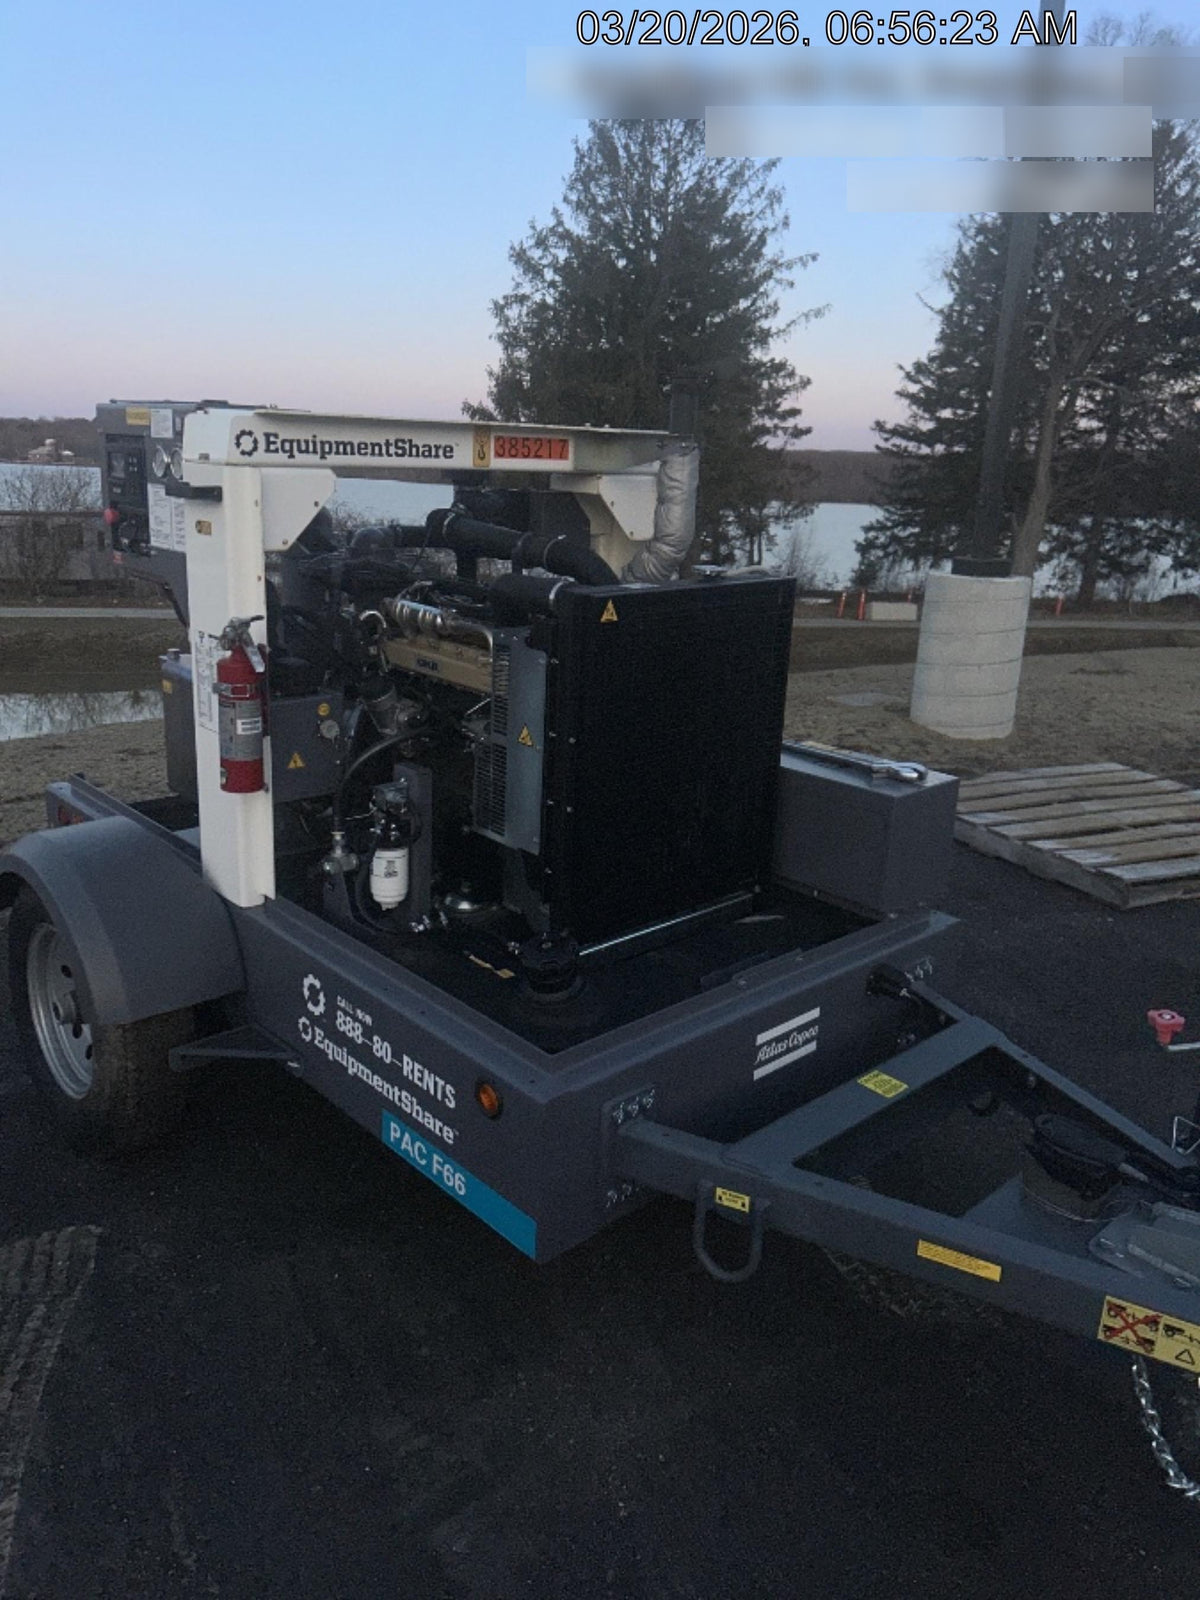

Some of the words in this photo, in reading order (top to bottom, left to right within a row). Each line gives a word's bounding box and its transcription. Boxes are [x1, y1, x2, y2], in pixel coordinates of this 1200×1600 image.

[262, 431, 455, 460] EquipmentShare
[495, 436, 568, 460] 385217
[335, 1010, 457, 1109] 888-80-RENTS
[754, 1042, 787, 1065] Atlas
[788, 1025, 820, 1048] Copco
[313, 1026, 455, 1145] EquipmentShare
[389, 1121, 428, 1166] PAC
[431, 1153, 467, 1196] F66
